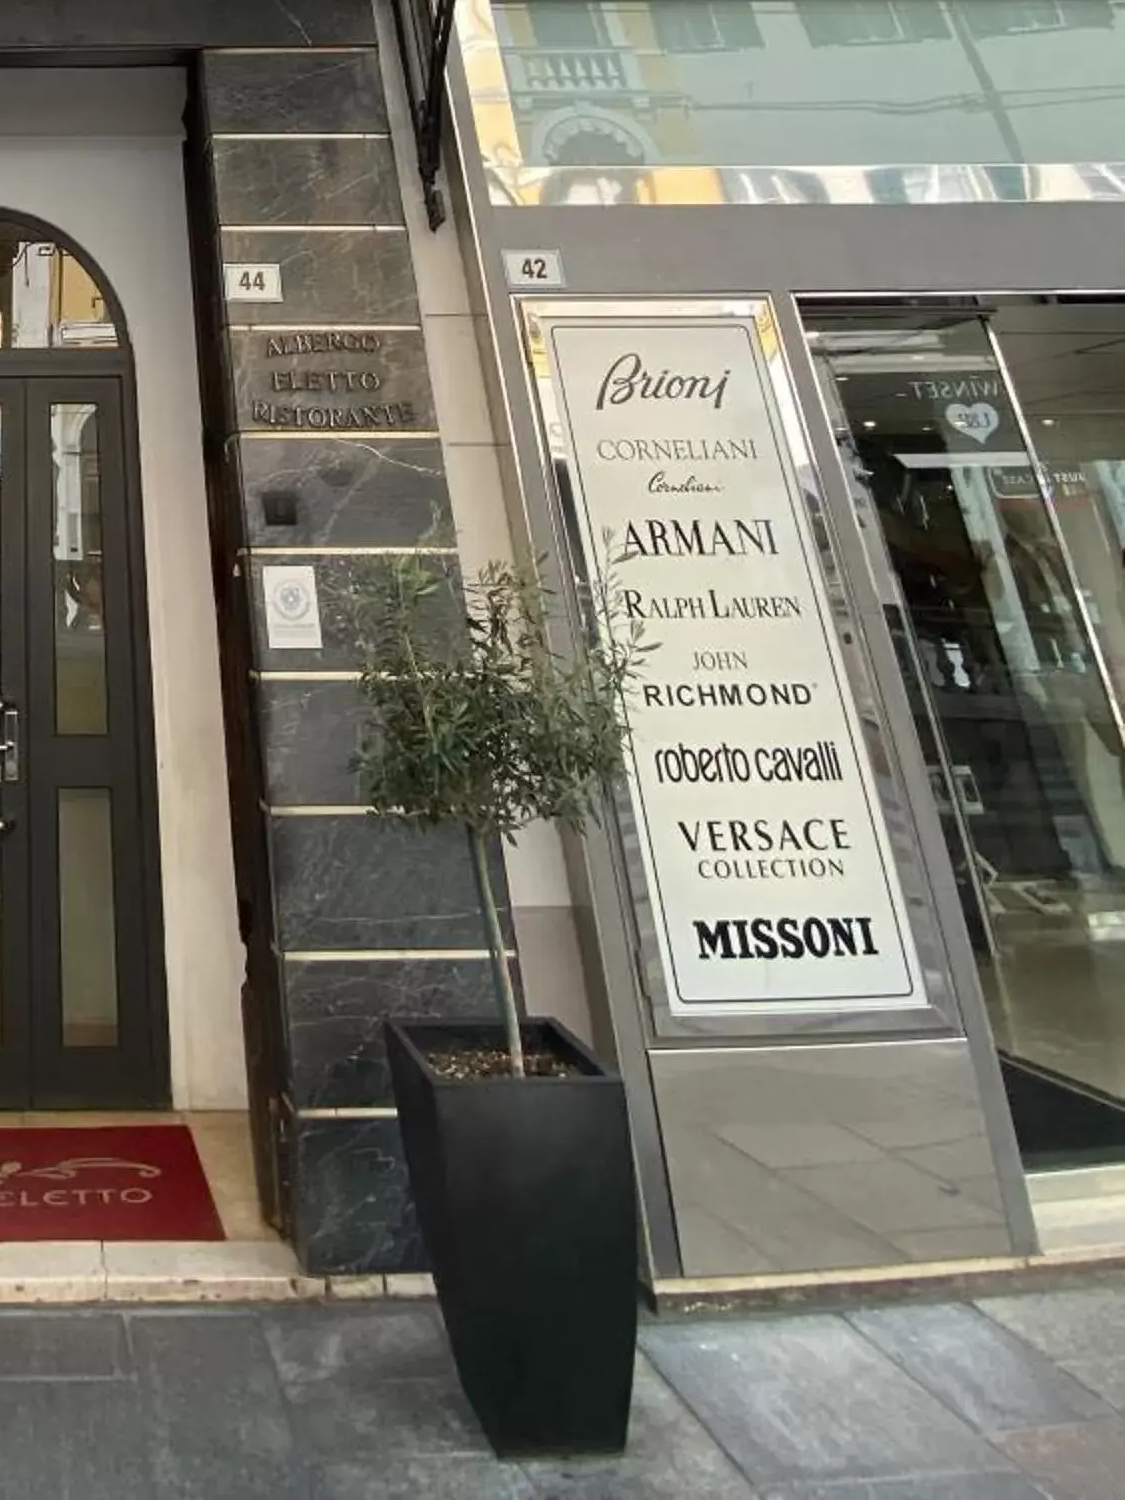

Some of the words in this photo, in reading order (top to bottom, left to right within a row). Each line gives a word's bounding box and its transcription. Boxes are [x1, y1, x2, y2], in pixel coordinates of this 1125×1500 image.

[521, 257, 548, 280] 42
[238, 271, 266, 292] 44
[266, 331, 382, 358] ALBERGO
[273, 371, 382, 393] ELETTO
[252, 401, 415, 429] RISTORANTE
[596, 438, 759, 462] CORNELIANI
[623, 519, 781, 557] ARMANI
[692, 650, 749, 672] JOHN
[642, 684, 812, 707] RICHMOND
[654, 742, 750, 783] roberto
[754, 741, 843, 782] cavalli
[678, 818, 851, 852] VERSACE
[697, 858, 845, 879] COLLECTION
[692, 916, 879, 960] MISSONI
